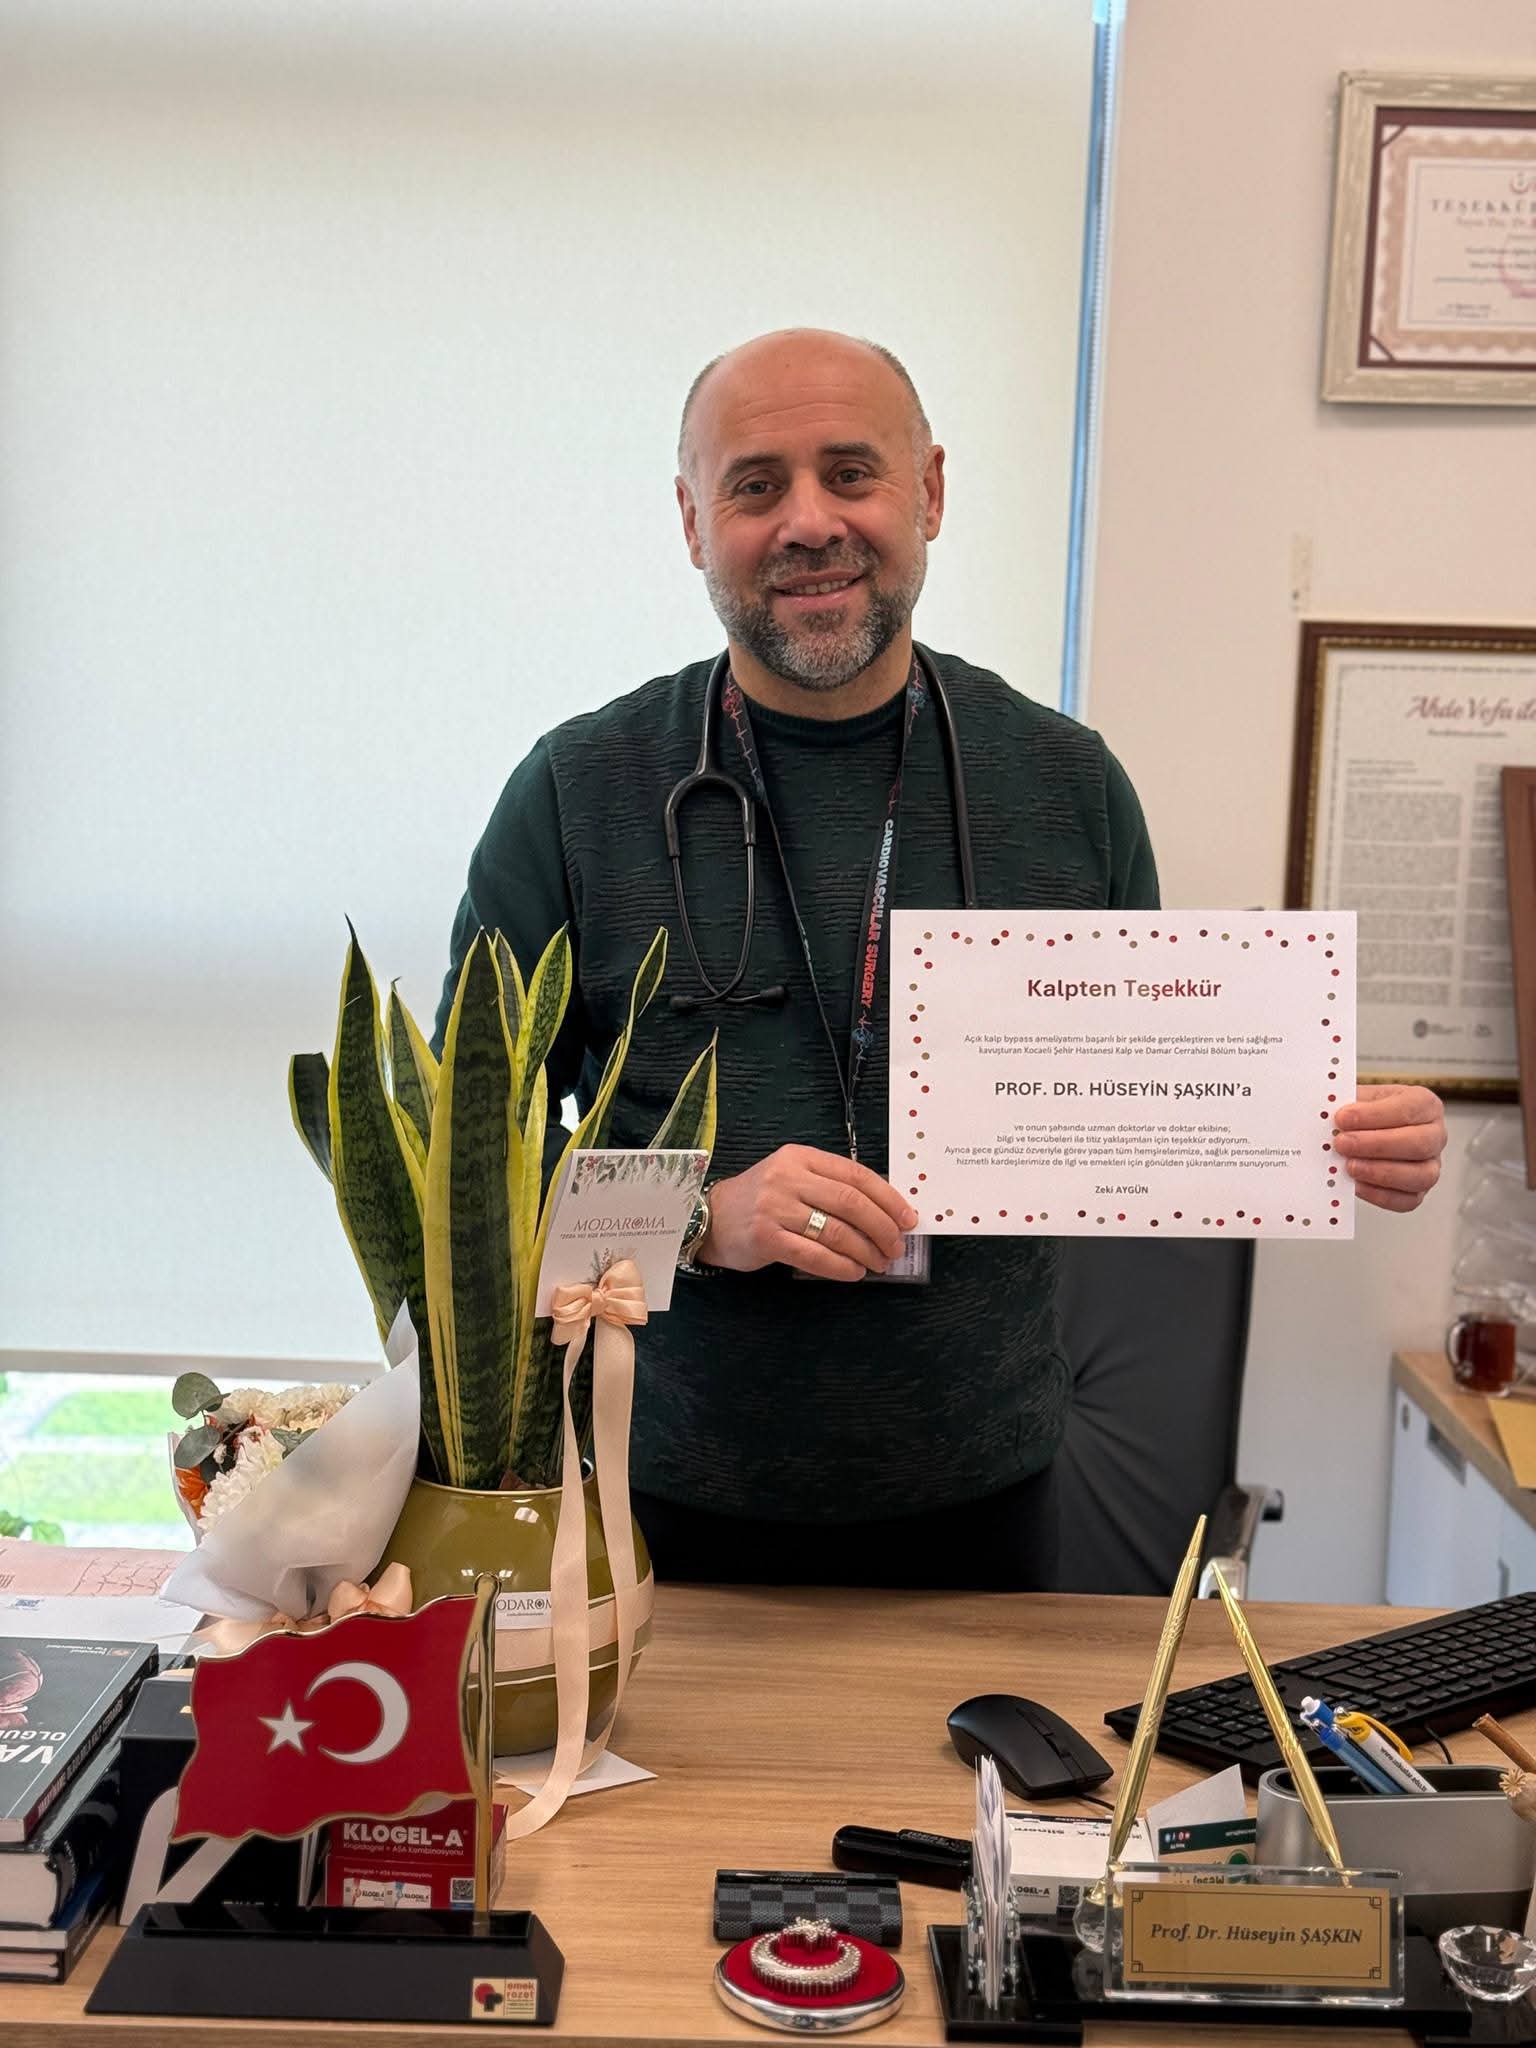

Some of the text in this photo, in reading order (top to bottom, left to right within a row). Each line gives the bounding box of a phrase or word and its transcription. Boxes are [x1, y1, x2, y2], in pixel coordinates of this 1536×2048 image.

[861, 819, 894, 1009] CARDIOVASCULAR SURGERY
[1027, 978, 1221, 1001] Kalpten Teşekkür
[964, 1035, 982, 1045] Açık
[984, 1035, 1002, 1045] kalp
[1004, 1035, 1034, 1045] bypass
[1084, 1035, 1114, 1045] başarılı
[1116, 1035, 1128, 1043] bir
[1128, 1035, 1156, 1045] şekilde
[1226, 1035, 1244, 1043] beni
[1246, 1035, 1284, 1046] sağlığıma
[978, 1047, 1022, 1056] kavuşturan
[1054, 1047, 1074, 1056] Şehir
[1114, 1047, 1132, 1056] Kalp
[1174, 1047, 1210, 1055] Cerrahisi
[1210, 1047, 1236, 1055] Bölüm
[1238, 1047, 1268, 1056] başkanı
[995, 1082, 1047, 1097] PROF.
[1054, 1082, 1083, 1097] DR.
[1089, 1080, 1168, 1097] HÜSEYİN
[1048, 1124, 1086, 1133] şahsında
[1198, 1125, 1232, 1134] ekibine;
[996, 1135, 1014, 1144] bilgi
[1154, 1136, 1170, 1145] için
[1171, 1136, 1206, 1145] teşekkür
[1208, 1137, 1250, 1145] ediyorum.
[944, 1146, 970, 1156] Ayrıca
[972, 1148, 992, 1156] gece
[994, 1146, 1024, 1156] gündüz
[1026, 1147, 1062, 1156] özveriyle
[1064, 1147, 1086, 1156] görev
[1088, 1148, 1114, 1156] yapan
[1115, 1147, 1132, 1155] tüm
[1204, 1148, 1230, 1157] sağlık
[956, 1158, 990, 1166] hizmetli
[1064, 1159, 1078, 1168] ilgi
[1128, 1159, 1144, 1168] için
[1144, 1159, 1184, 1168] gönülden
[1238, 1161, 1288, 1169] sunuyorum.
[1094, 1183, 1149, 1195] Zeki AYGÜN
[573, 1216, 665, 1232] MODAROMA
[343, 1822, 464, 1847] KLOGEL-A
[1151, 1923, 1363, 1946] Prof. Dr. Hüseyin ŞAŞKIN
